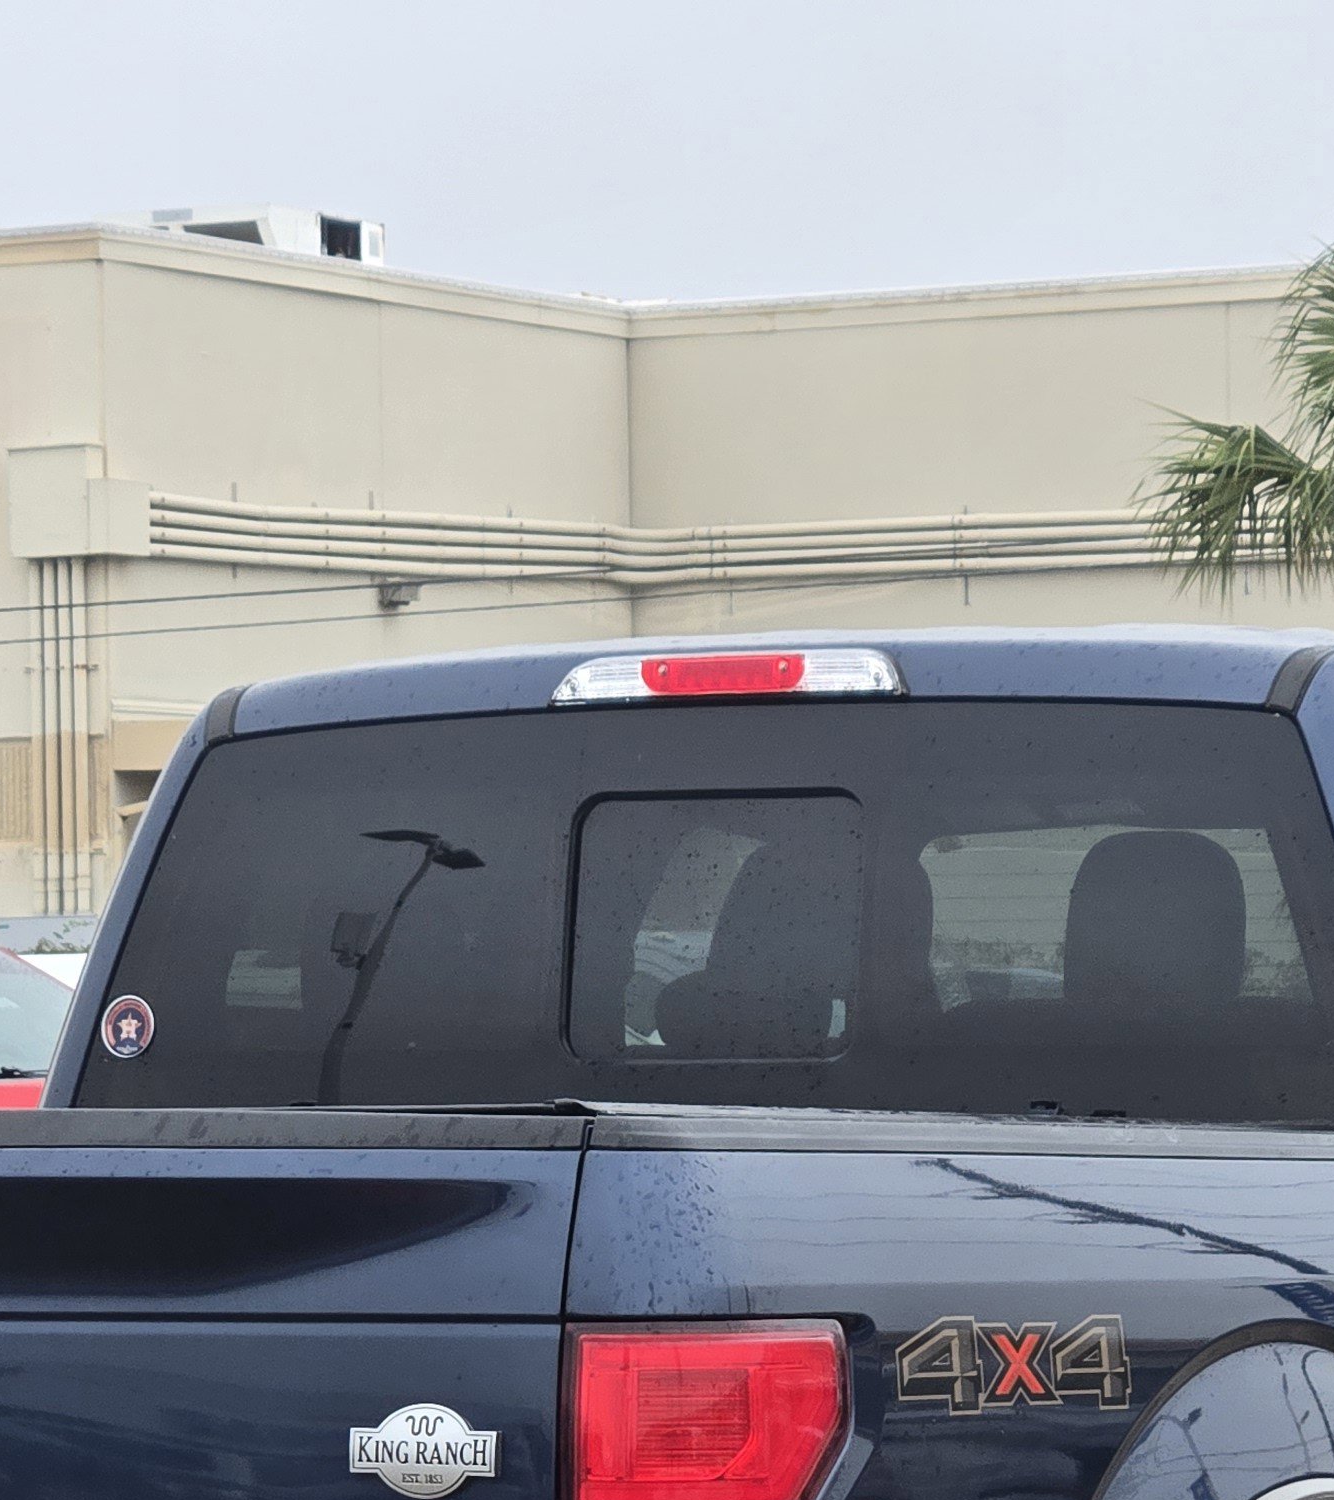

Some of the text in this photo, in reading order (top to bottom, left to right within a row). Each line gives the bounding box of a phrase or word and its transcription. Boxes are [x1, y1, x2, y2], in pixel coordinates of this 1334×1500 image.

[357, 1436, 488, 1467] KING RANCH
[424, 1474, 443, 1485] 1853
